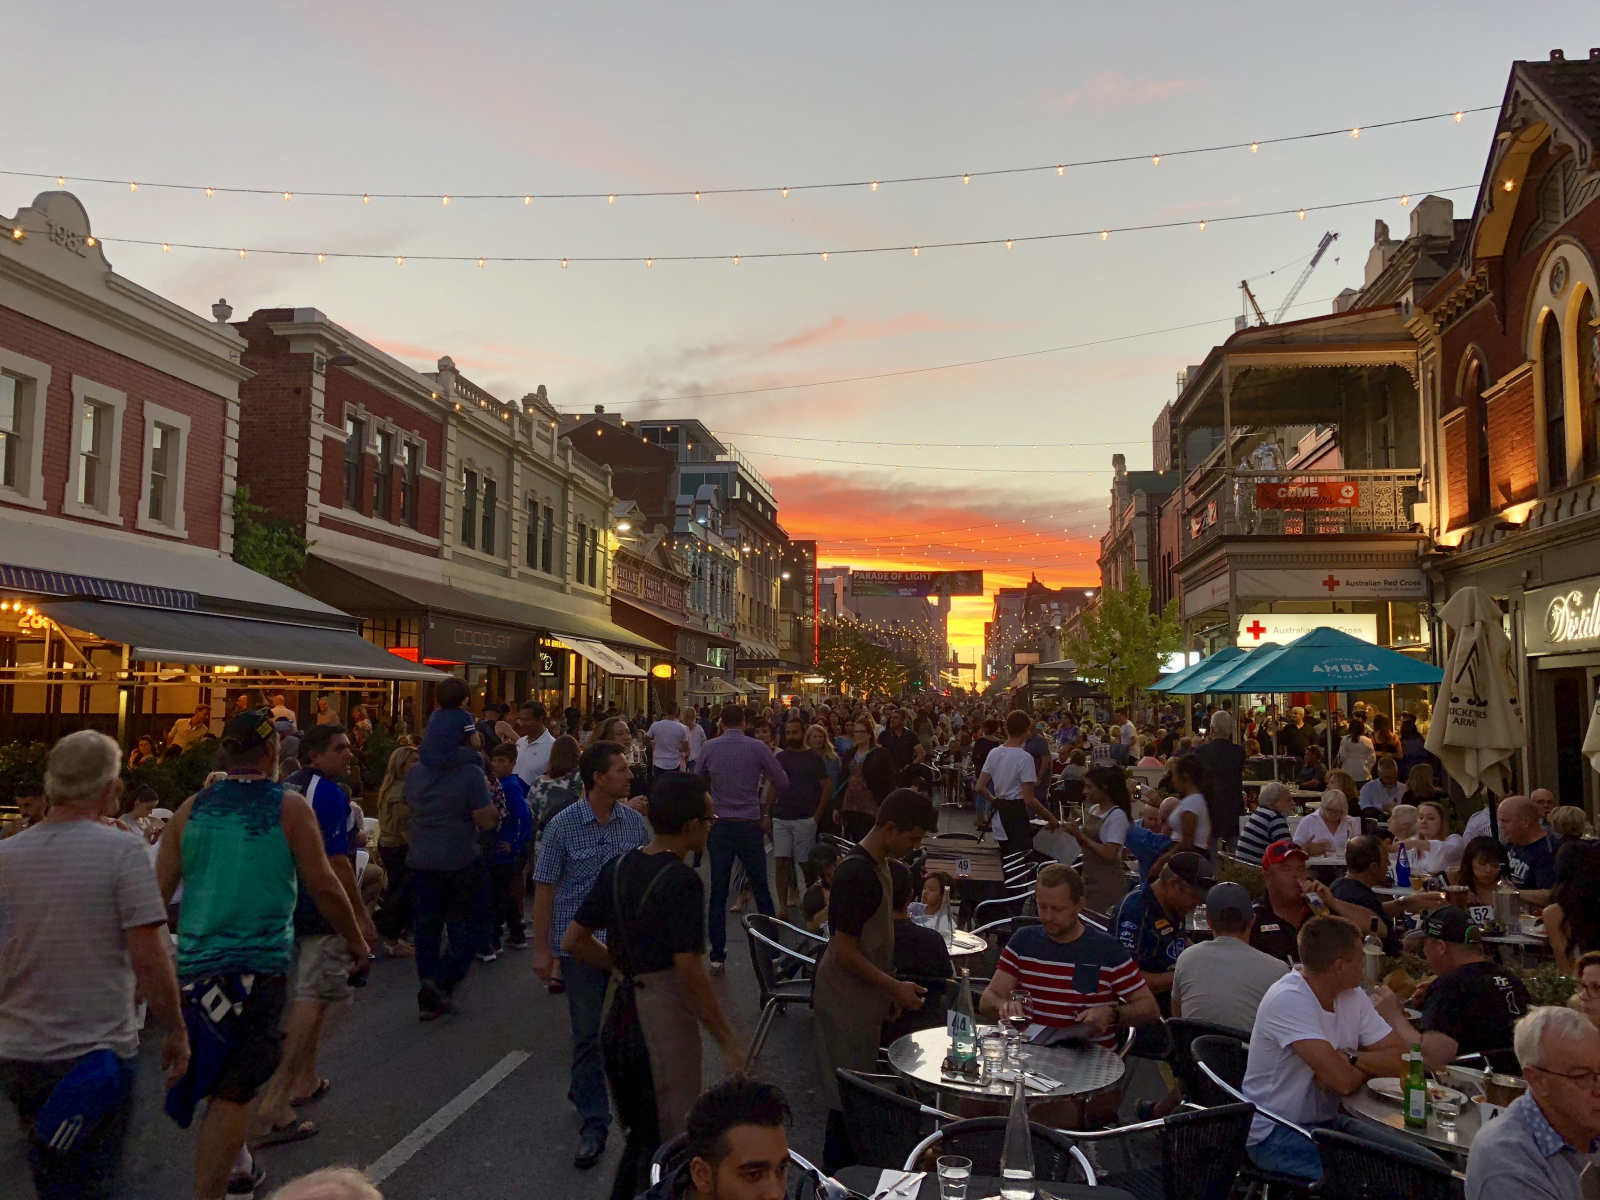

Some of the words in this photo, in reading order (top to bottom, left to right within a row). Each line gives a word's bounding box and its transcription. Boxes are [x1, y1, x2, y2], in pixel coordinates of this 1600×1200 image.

[1277, 487, 1319, 498] COME
[853, 572, 889, 580] PARADE
[891, 572, 902, 580] OF
[905, 572, 932, 580] LIGHT
[454, 628, 511, 649] COCOLAT
[1312, 663, 1379, 673] AMBRA
[958, 860, 969, 870] 49
[1474, 907, 1489, 921] 52
